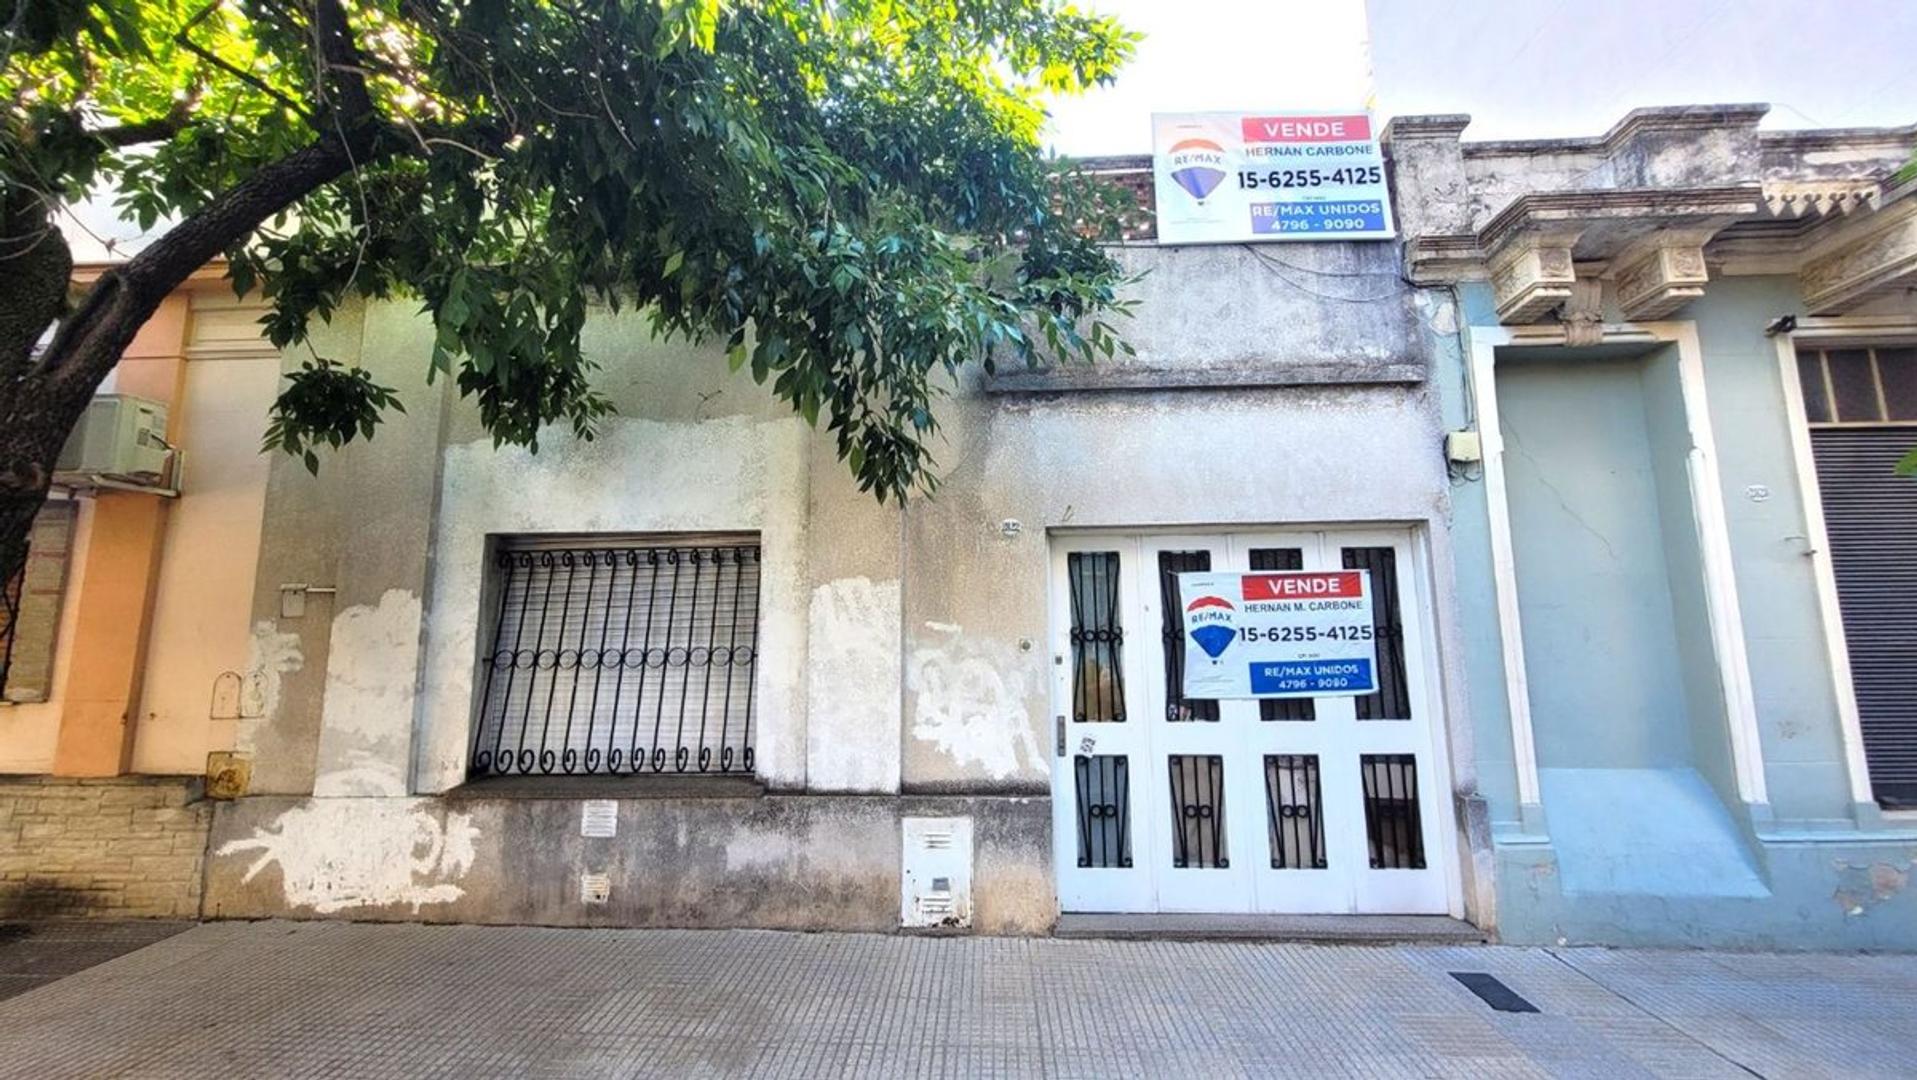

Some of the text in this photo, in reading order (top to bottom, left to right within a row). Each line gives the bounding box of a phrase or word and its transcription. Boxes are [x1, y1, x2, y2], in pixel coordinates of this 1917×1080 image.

[1264, 122, 1345, 138] VENDE
[1246, 144, 1373, 158] HERNAN CARBONE
[1174, 153, 1222, 166] RE/MAX
[1238, 166, 1381, 189] 15-6255-4125
[1252, 203, 1381, 217] RE/MAX UNIDOS
[1271, 219, 1309, 231] 4796
[1324, 218, 1365, 230] 9090
[1268, 578, 1341, 594] VENDE
[1245, 600, 1364, 613] HERNAN M. CARBONE
[1191, 612, 1232, 623] RE/MAX
[1239, 625, 1372, 642] 15-6255-4125
[1264, 664, 1359, 677] RE/MAX UNIDOS
[1278, 679, 1306, 689] 4796
